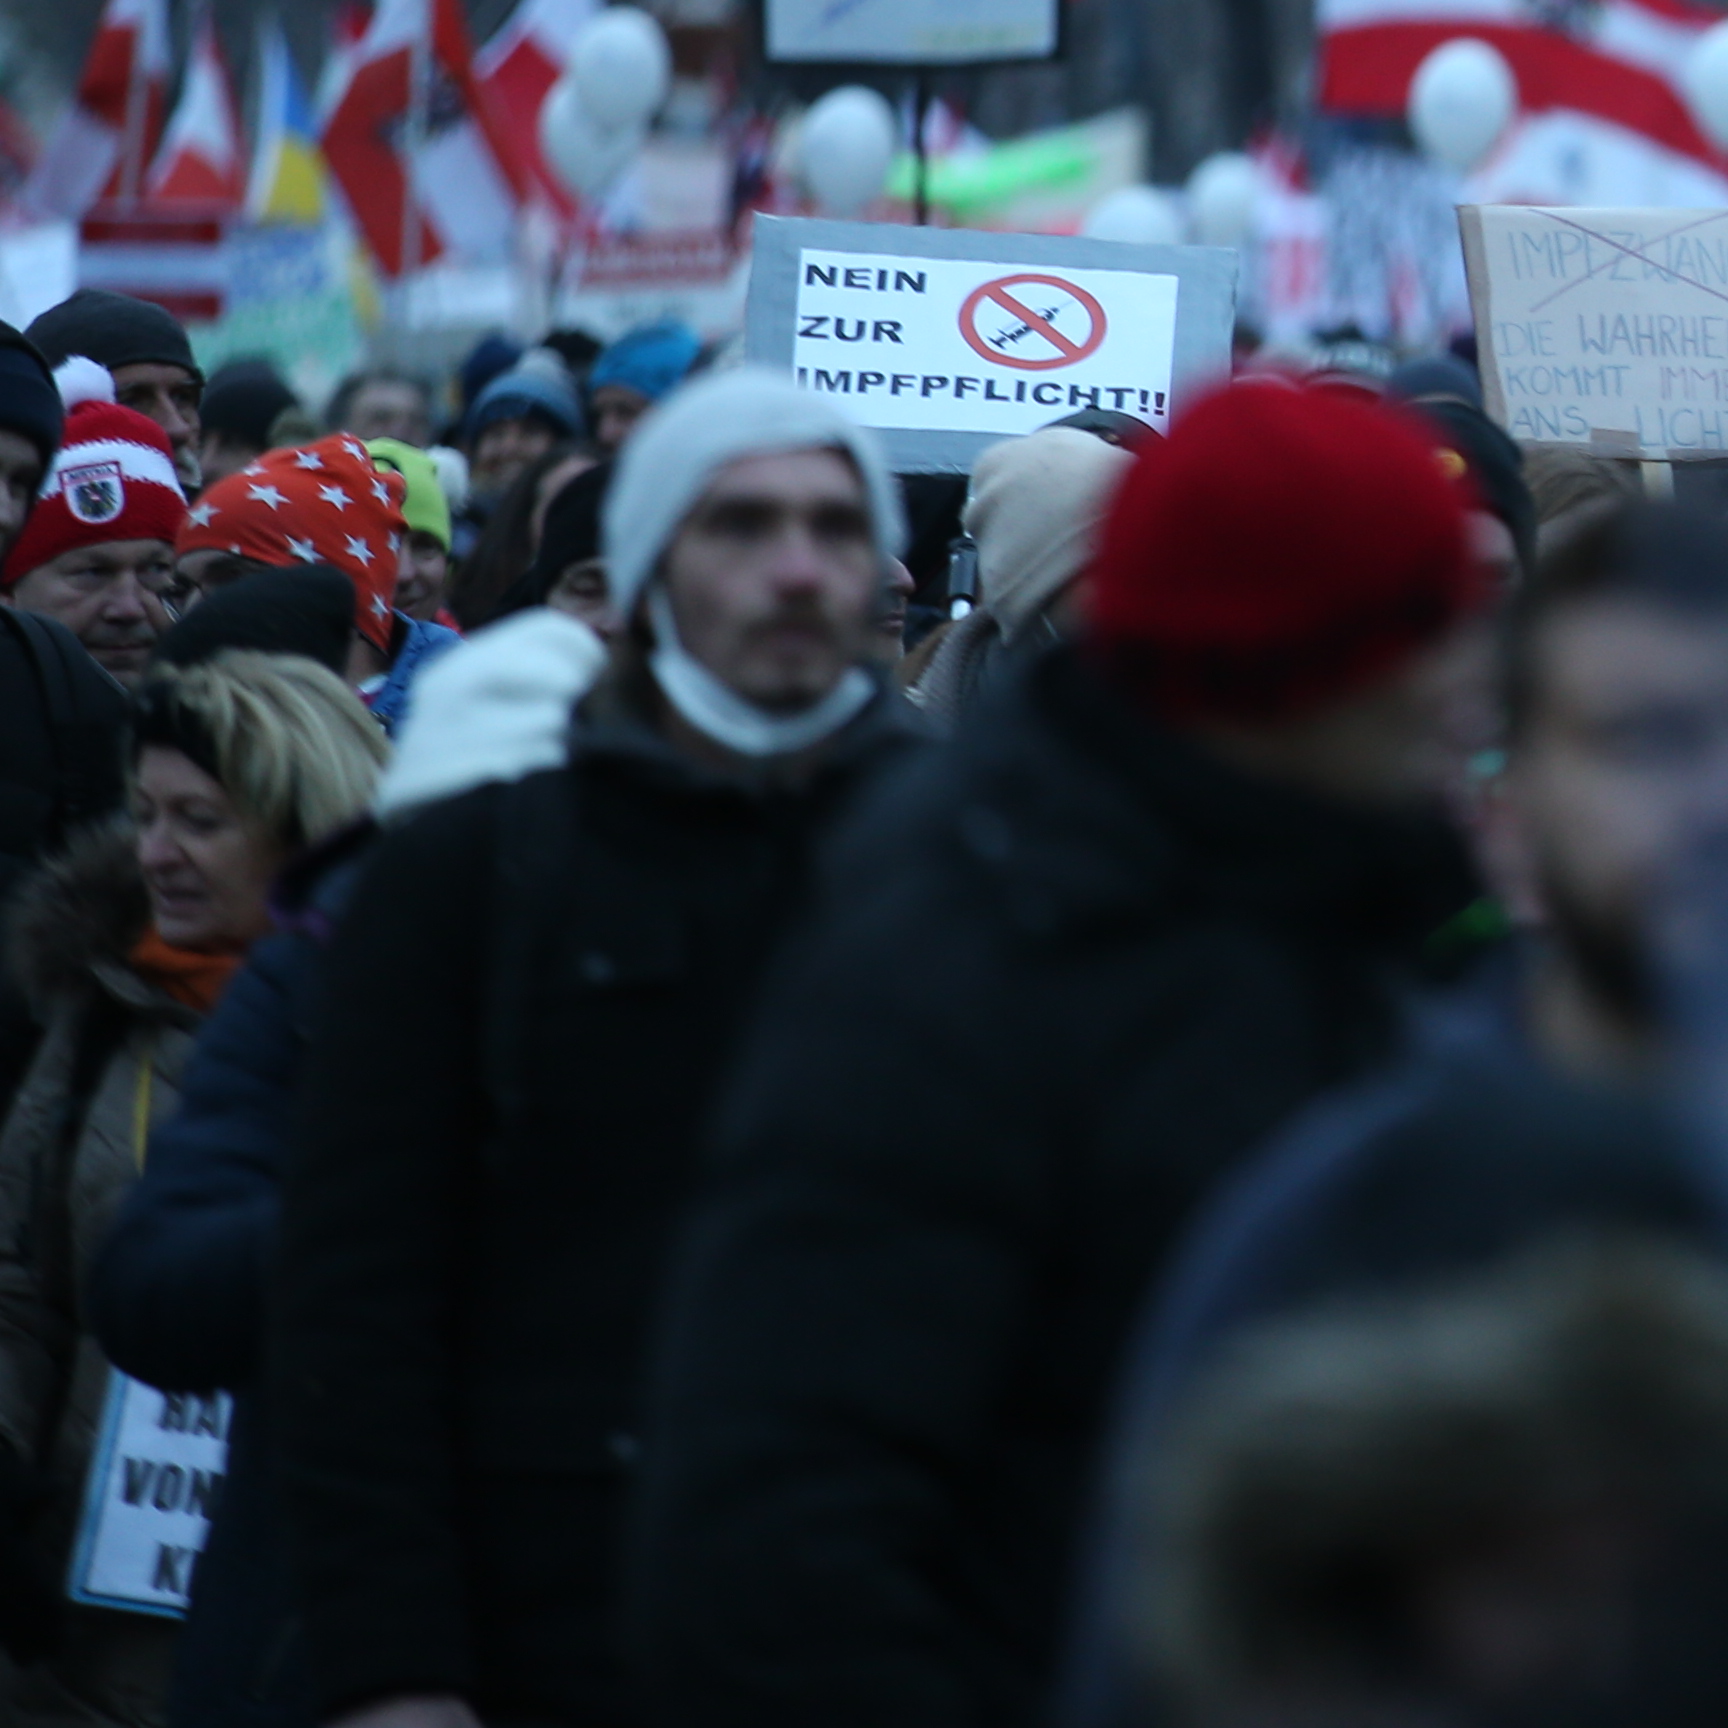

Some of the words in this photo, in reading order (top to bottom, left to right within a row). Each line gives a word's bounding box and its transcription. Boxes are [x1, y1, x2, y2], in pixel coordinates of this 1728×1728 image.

[805, 263, 927, 294] NEIN
[797, 315, 906, 345] ZUR
[1499, 320, 1553, 358] DIE
[796, 366, 1167, 417] IMPFPFLICHT!!
[1504, 365, 1632, 398] KOMMT
[1511, 405, 1589, 437] ANS
